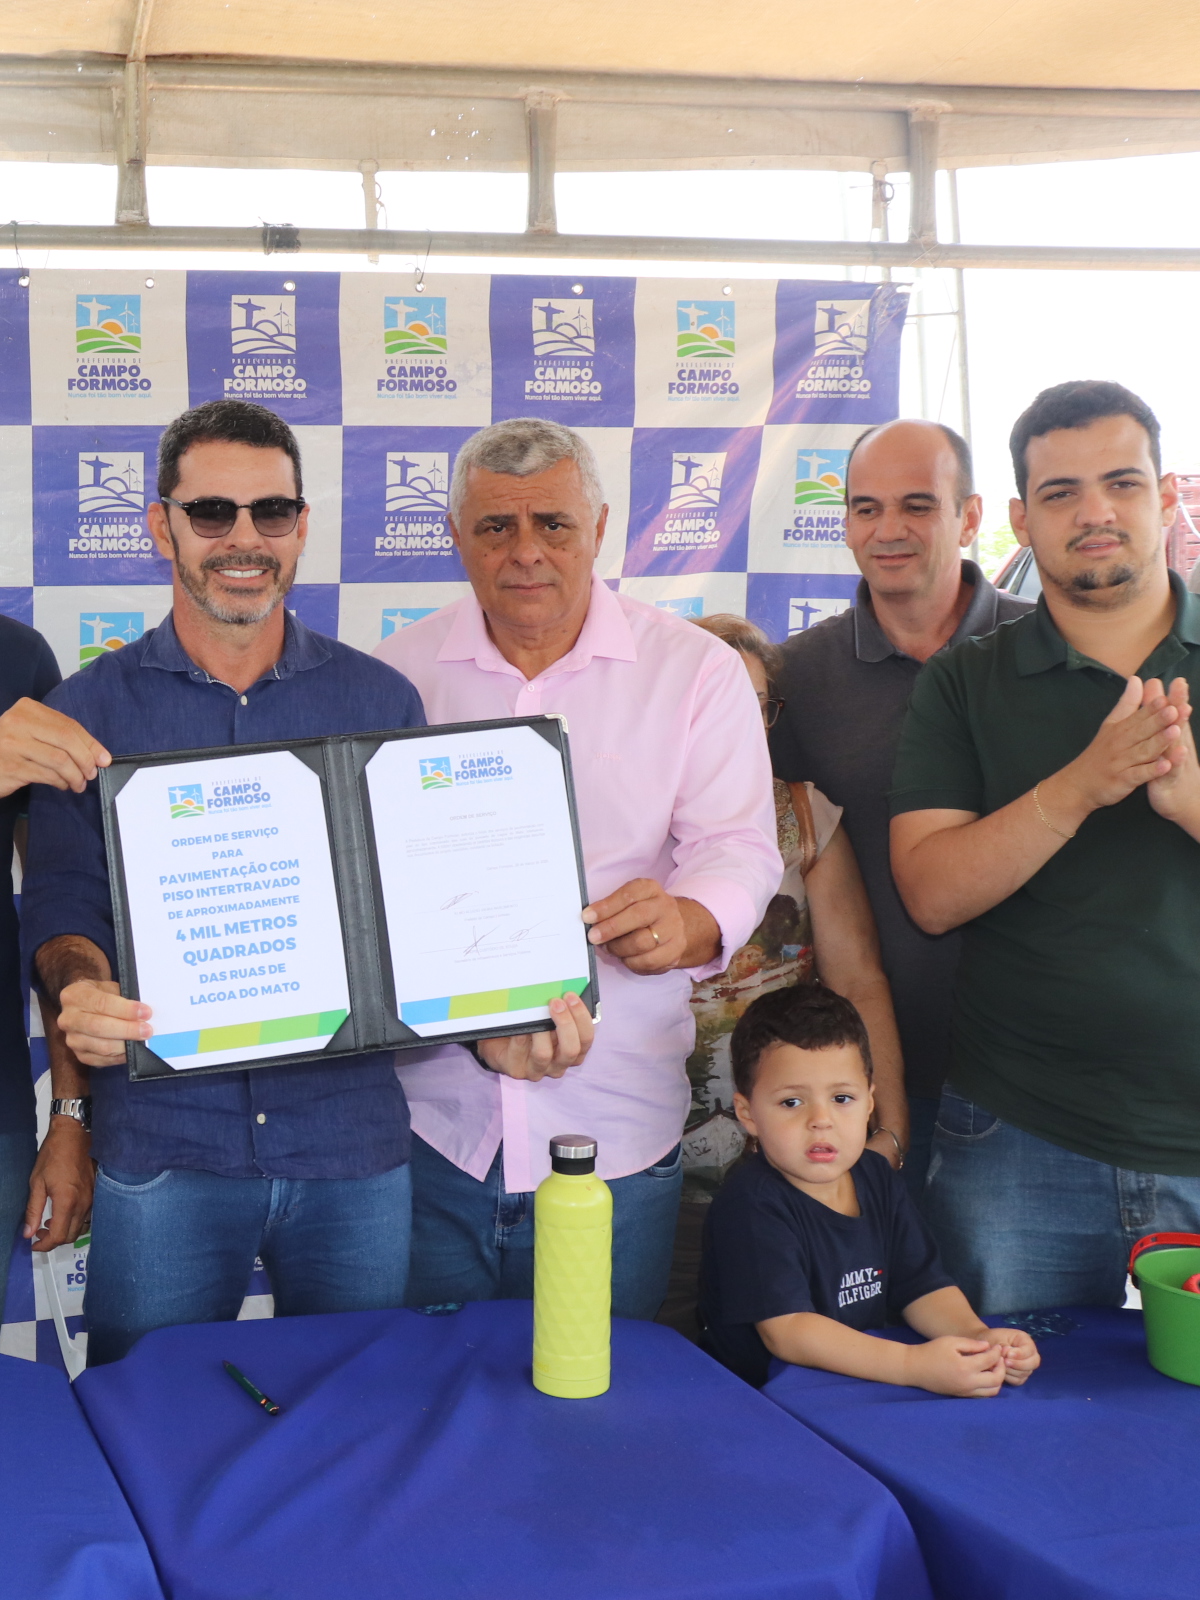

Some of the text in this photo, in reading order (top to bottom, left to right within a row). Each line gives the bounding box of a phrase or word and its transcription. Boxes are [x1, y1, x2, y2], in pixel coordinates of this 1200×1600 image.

[77, 365, 141, 378] CAMPO
[233, 365, 296, 378] CAMPO
[386, 366, 447, 379] CAMPO
[534, 367, 593, 381] CAMPO
[677, 369, 733, 382] CAMPO
[807, 365, 863, 379] CAMPO
[67, 378, 152, 392] FORMOSO
[224, 378, 307, 392] FORMOSO
[377, 379, 458, 392] FORMOSO
[525, 380, 602, 394] FORMOSO
[668, 382, 740, 395] FORMOSO
[797, 378, 872, 392] FORMOSO
[79, 524, 142, 538] CAMPO
[385, 523, 445, 536] CAMPO
[663, 518, 716, 532] CAMPO
[69, 537, 153, 552] FORMOSO
[375, 535, 454, 550] FORMOSO
[653, 530, 723, 545] FORMOSO
[460, 756, 504, 769] CAMPO
[455, 765, 512, 780] FORMOSO
[213, 782, 261, 797] CAMPO
[207, 792, 271, 809] FORMOSO
[171, 827, 279, 847] ORDEM DE SERVIÇO
[212, 849, 243, 860] PARA
[159, 859, 299, 886] PAVIMENTAÇÃO COM
[163, 876, 300, 902] PISO INTERTRAVADO
[168, 895, 300, 920] DE APROXIMADAMENTE
[176, 914, 297, 942] 4 MIL METROS
[183, 937, 297, 966] QUADRADOS
[199, 963, 286, 984] DAS RUAS DE
[190, 981, 300, 1005] LAGOA DO MATO
